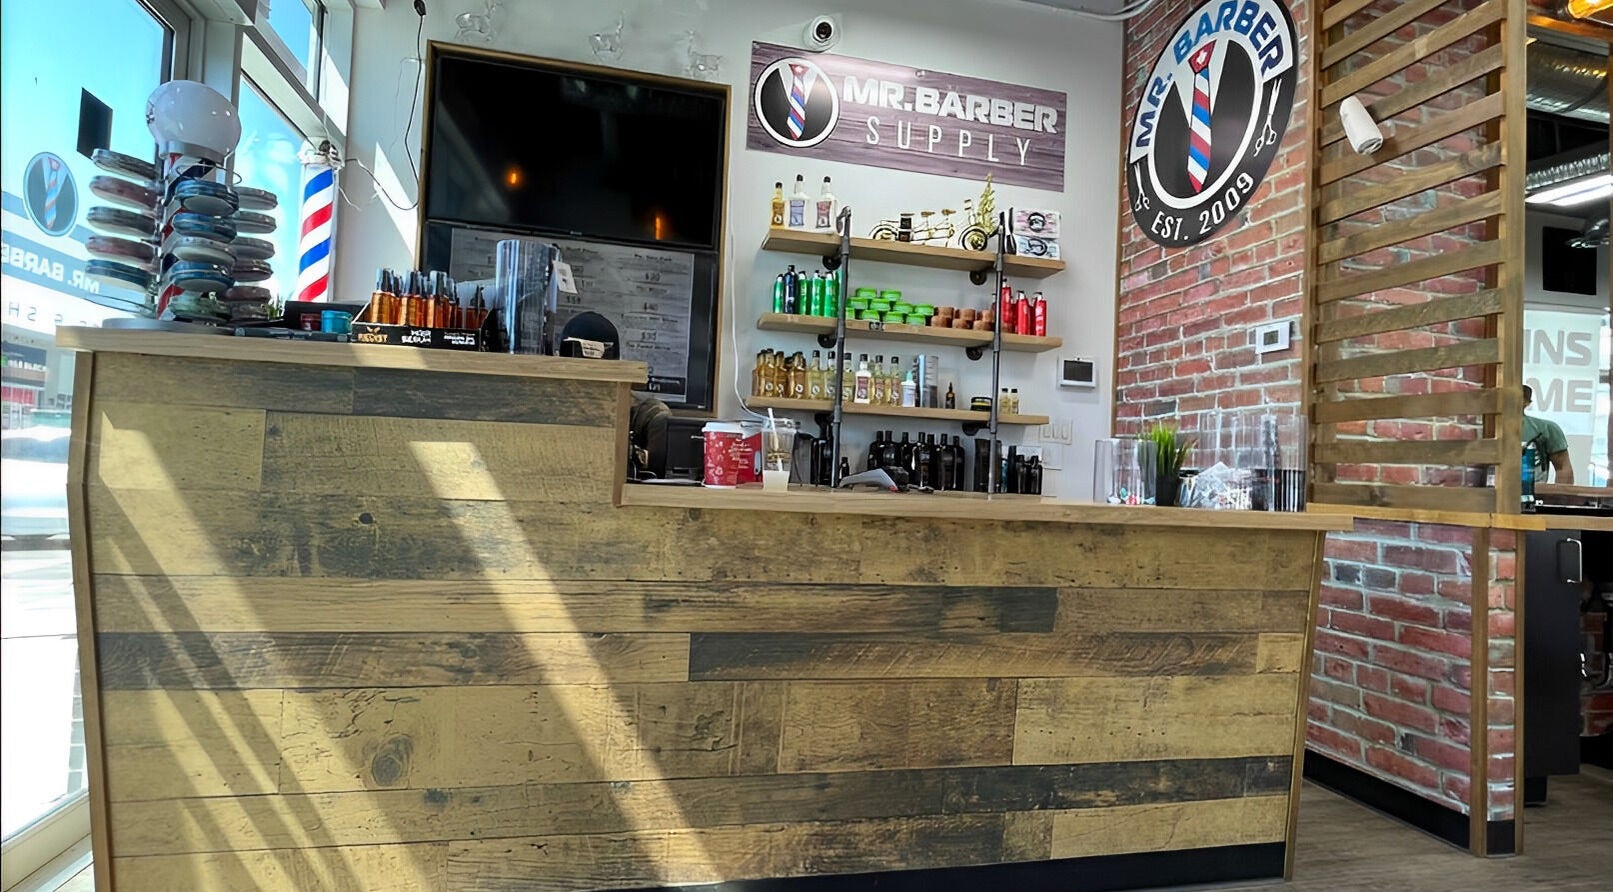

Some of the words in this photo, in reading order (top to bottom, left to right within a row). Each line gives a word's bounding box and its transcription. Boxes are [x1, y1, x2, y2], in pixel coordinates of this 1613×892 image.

[1135, 72, 1173, 149] MR.
[1172, 0, 1285, 79] BARBER
[866, 116, 1032, 166] SUPPLY
[1150, 210, 1190, 242] EST.
[1199, 172, 1255, 235] 2009
